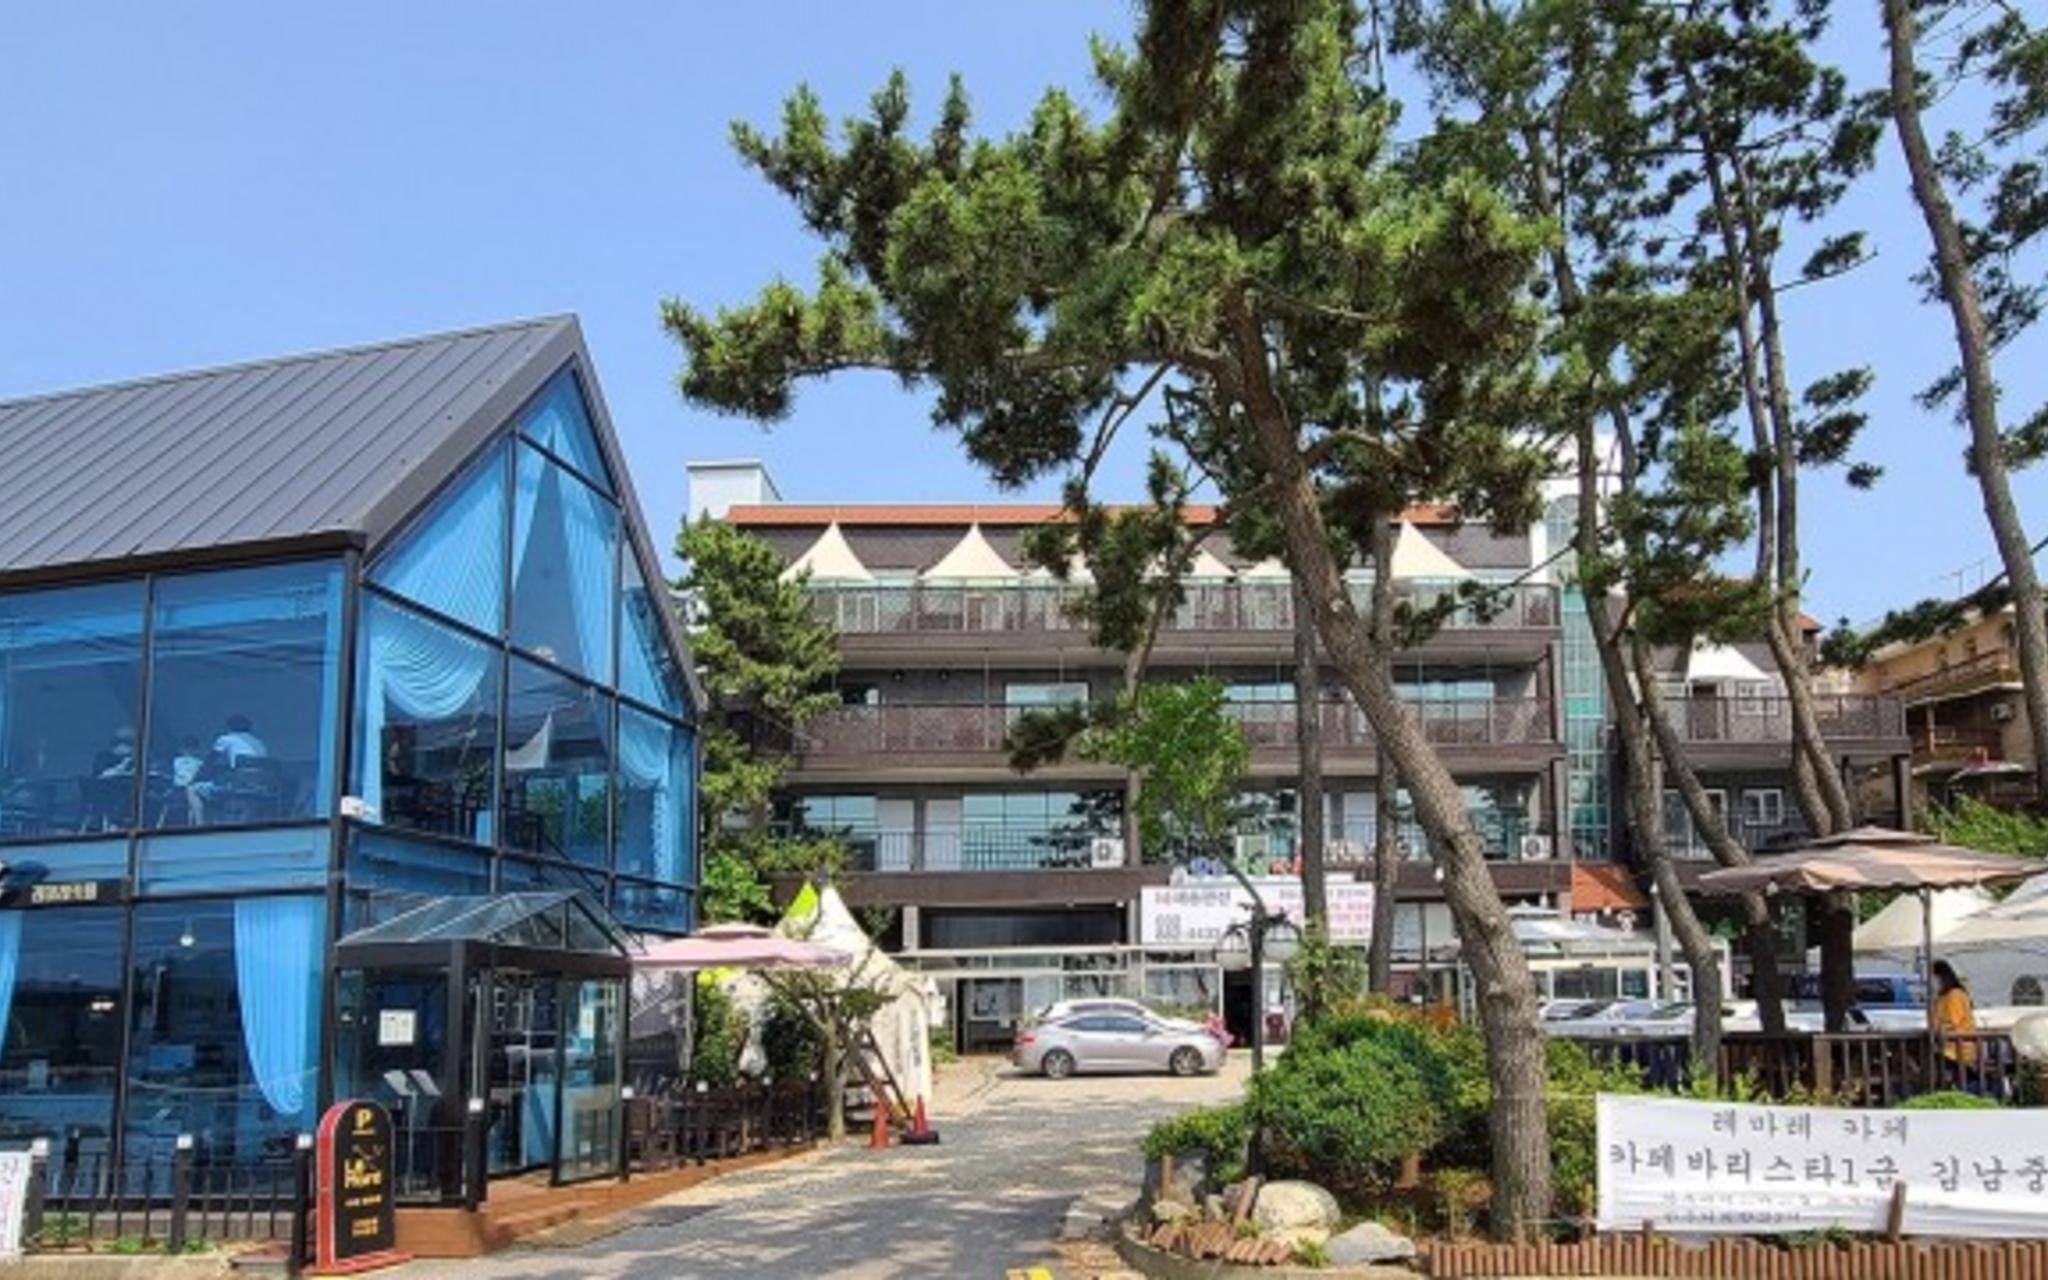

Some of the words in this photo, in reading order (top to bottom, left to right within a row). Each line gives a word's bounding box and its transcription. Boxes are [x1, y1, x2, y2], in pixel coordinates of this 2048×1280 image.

[354, 1109, 373, 1129] P
[1712, 1108, 1811, 1140] 레마레
[1843, 1113, 1908, 1144] 카페
